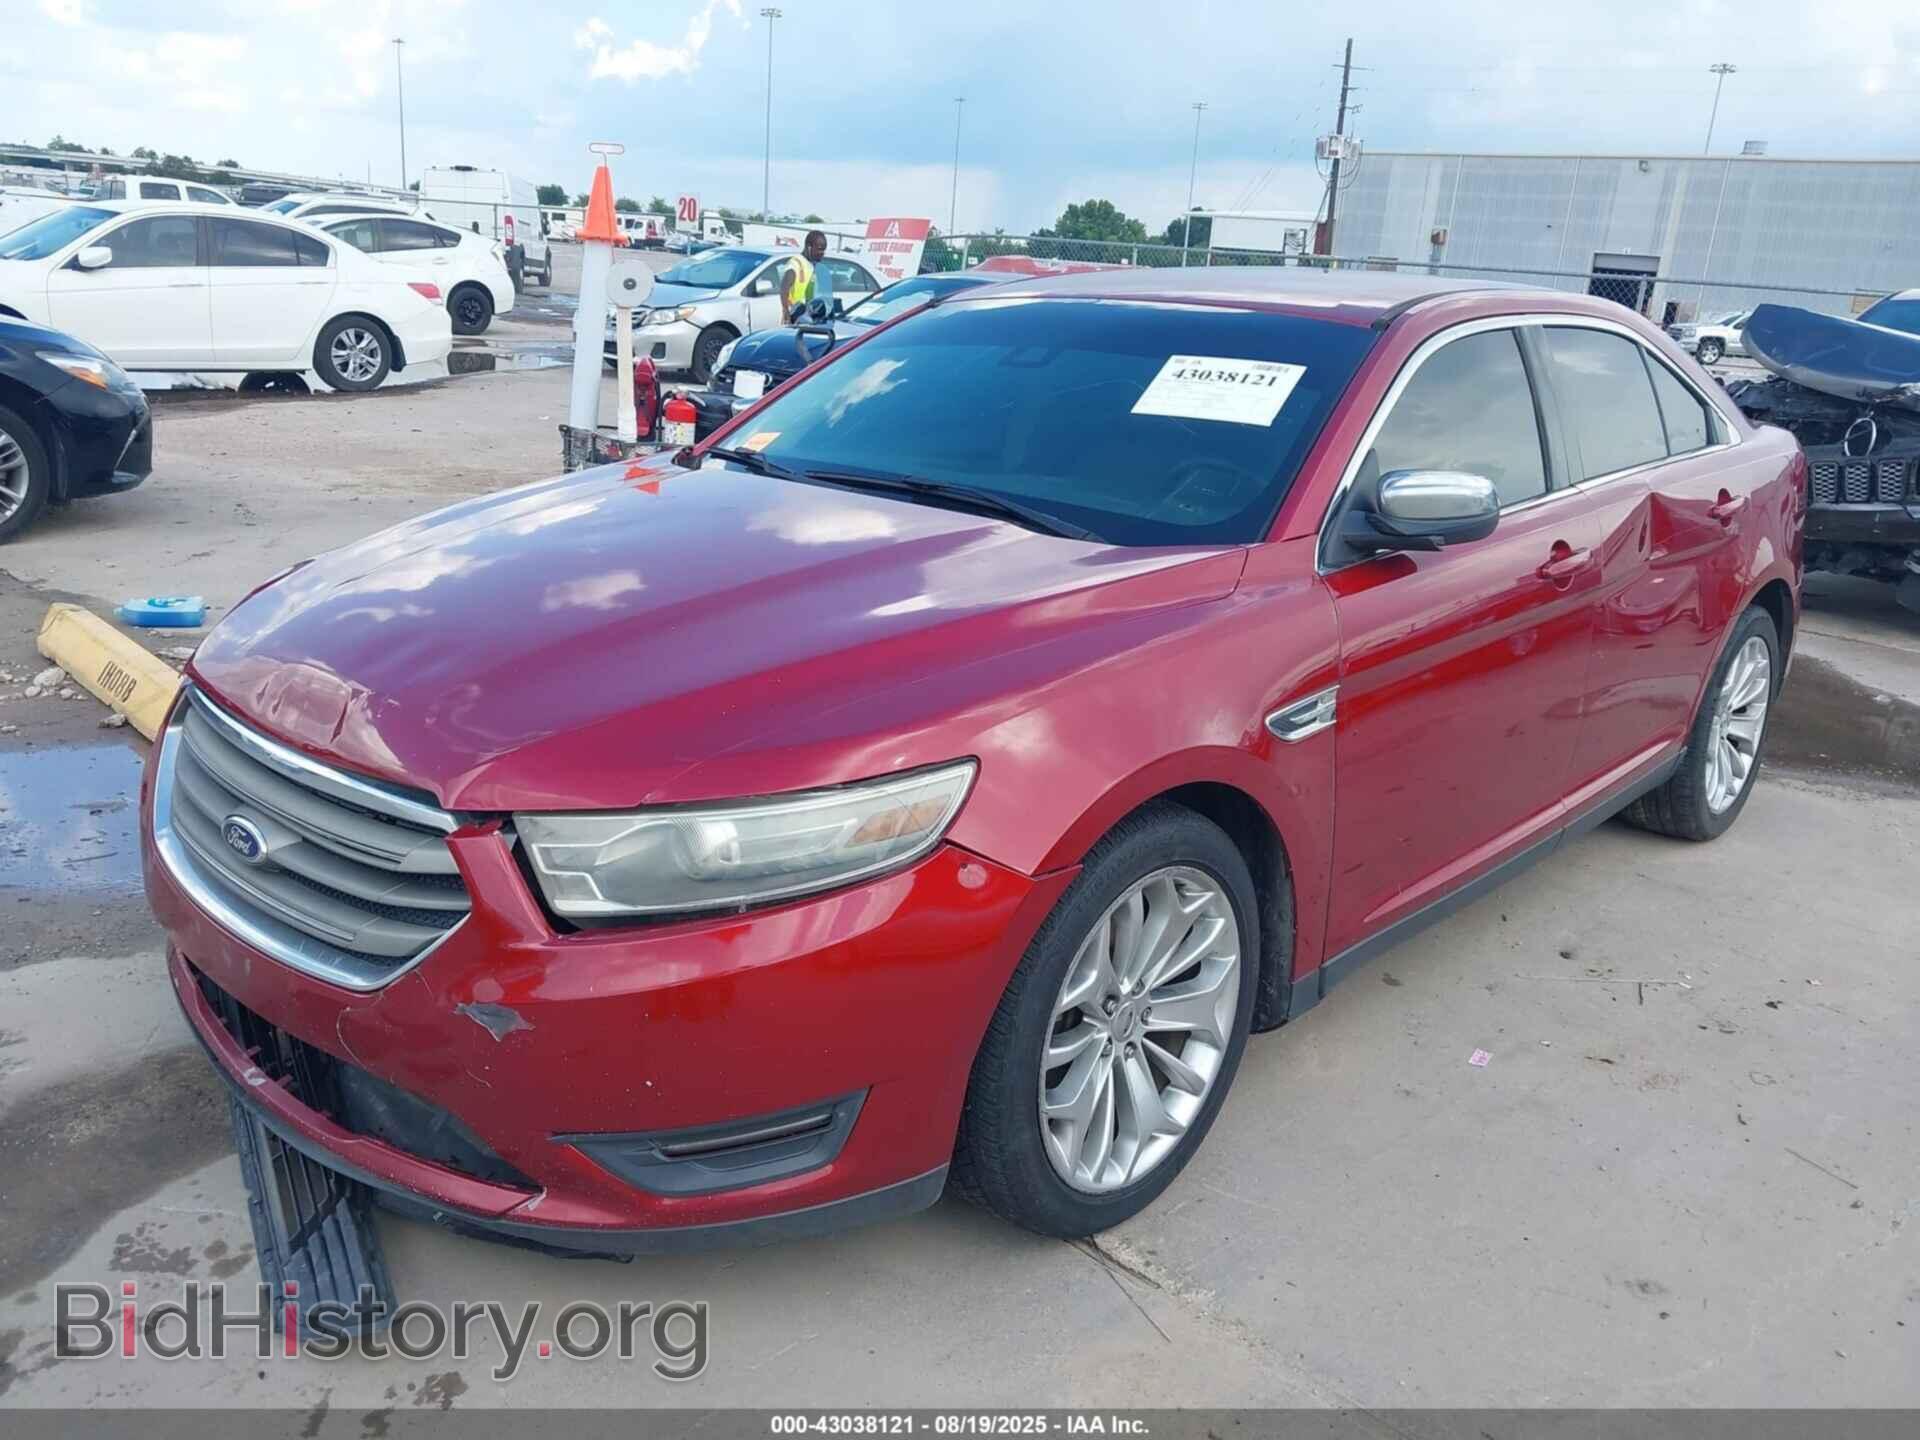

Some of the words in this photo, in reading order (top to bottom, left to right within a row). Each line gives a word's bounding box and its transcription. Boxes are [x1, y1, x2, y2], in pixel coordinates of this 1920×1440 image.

[678, 197, 697, 222] 20
[1172, 368, 1278, 387] 43038121
[227, 824, 252, 855] Ford
